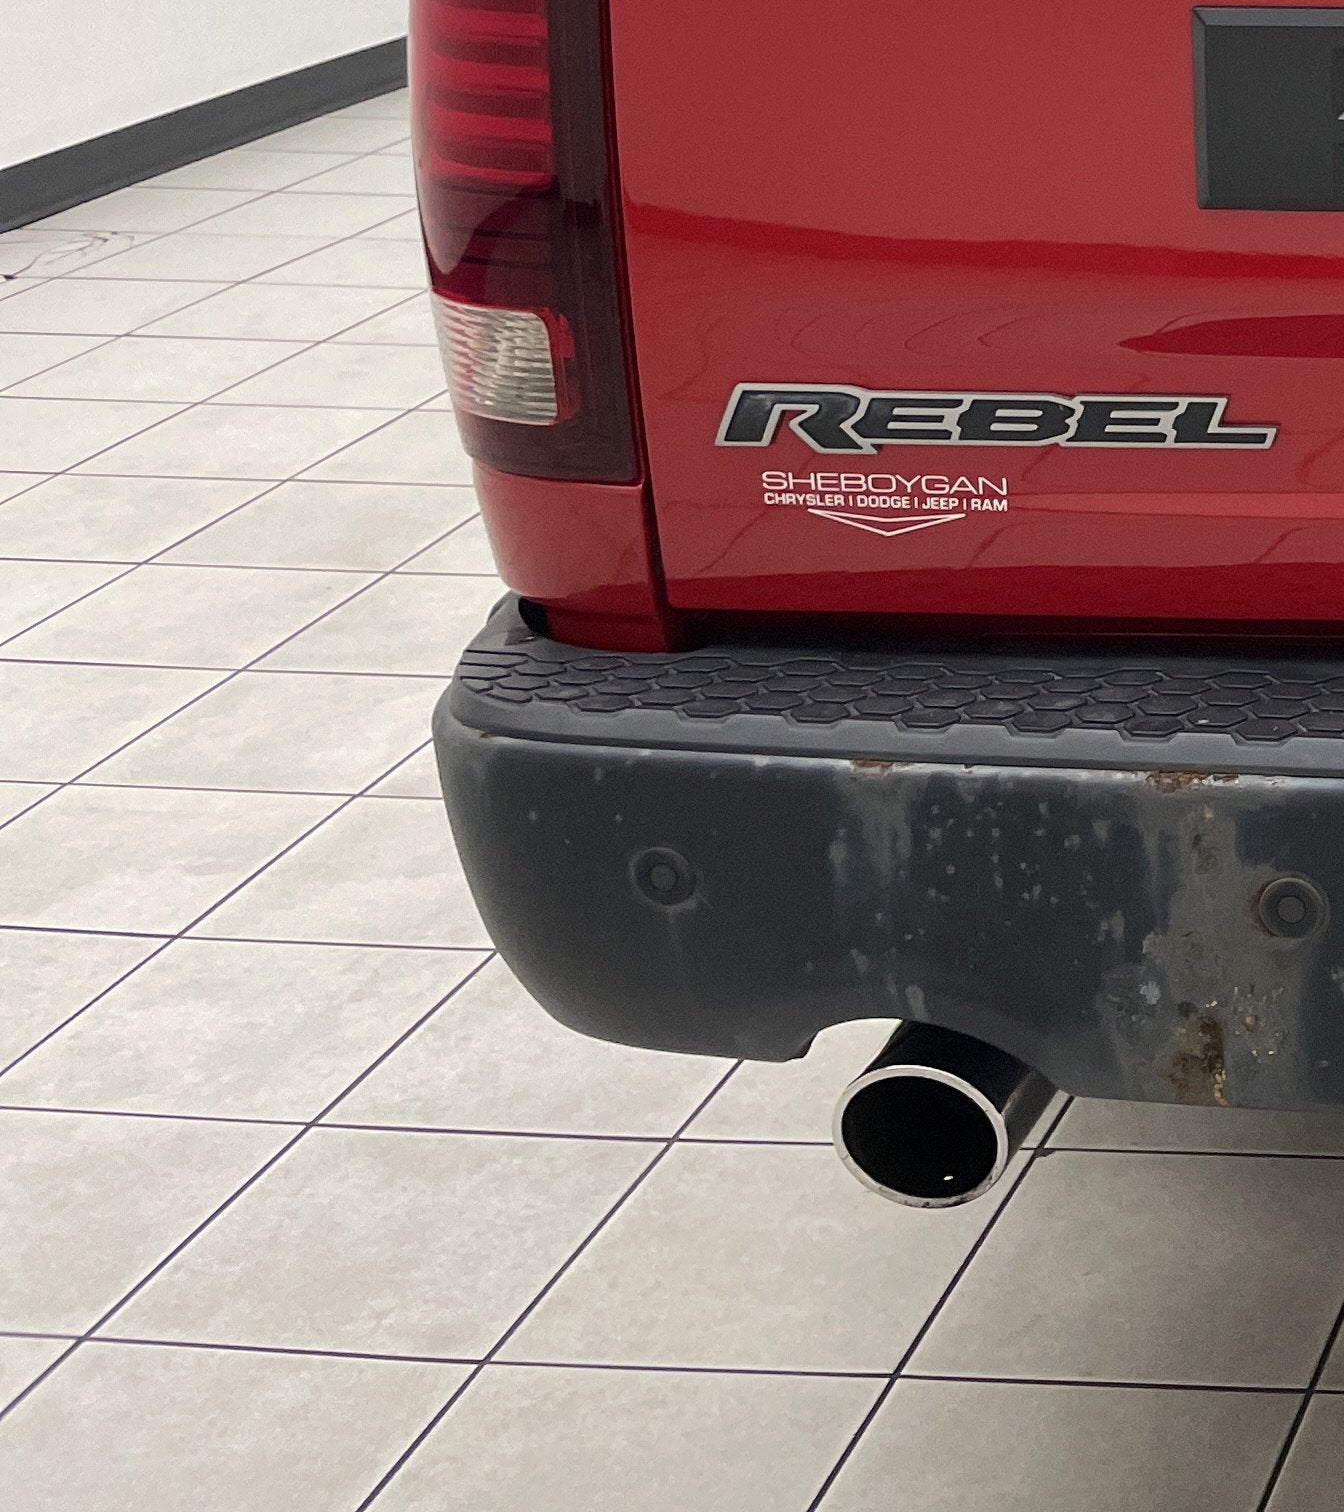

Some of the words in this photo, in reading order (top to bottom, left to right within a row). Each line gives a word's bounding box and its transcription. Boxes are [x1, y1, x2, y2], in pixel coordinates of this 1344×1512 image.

[714, 382, 1278, 455] REBEL
[761, 471, 1008, 496] SHEBOYGAN
[763, 492, 845, 507] CHRYSLER
[857, 495, 911, 509] DODGE
[922, 496, 959, 510] JEEP
[970, 498, 1008, 512] RAM
